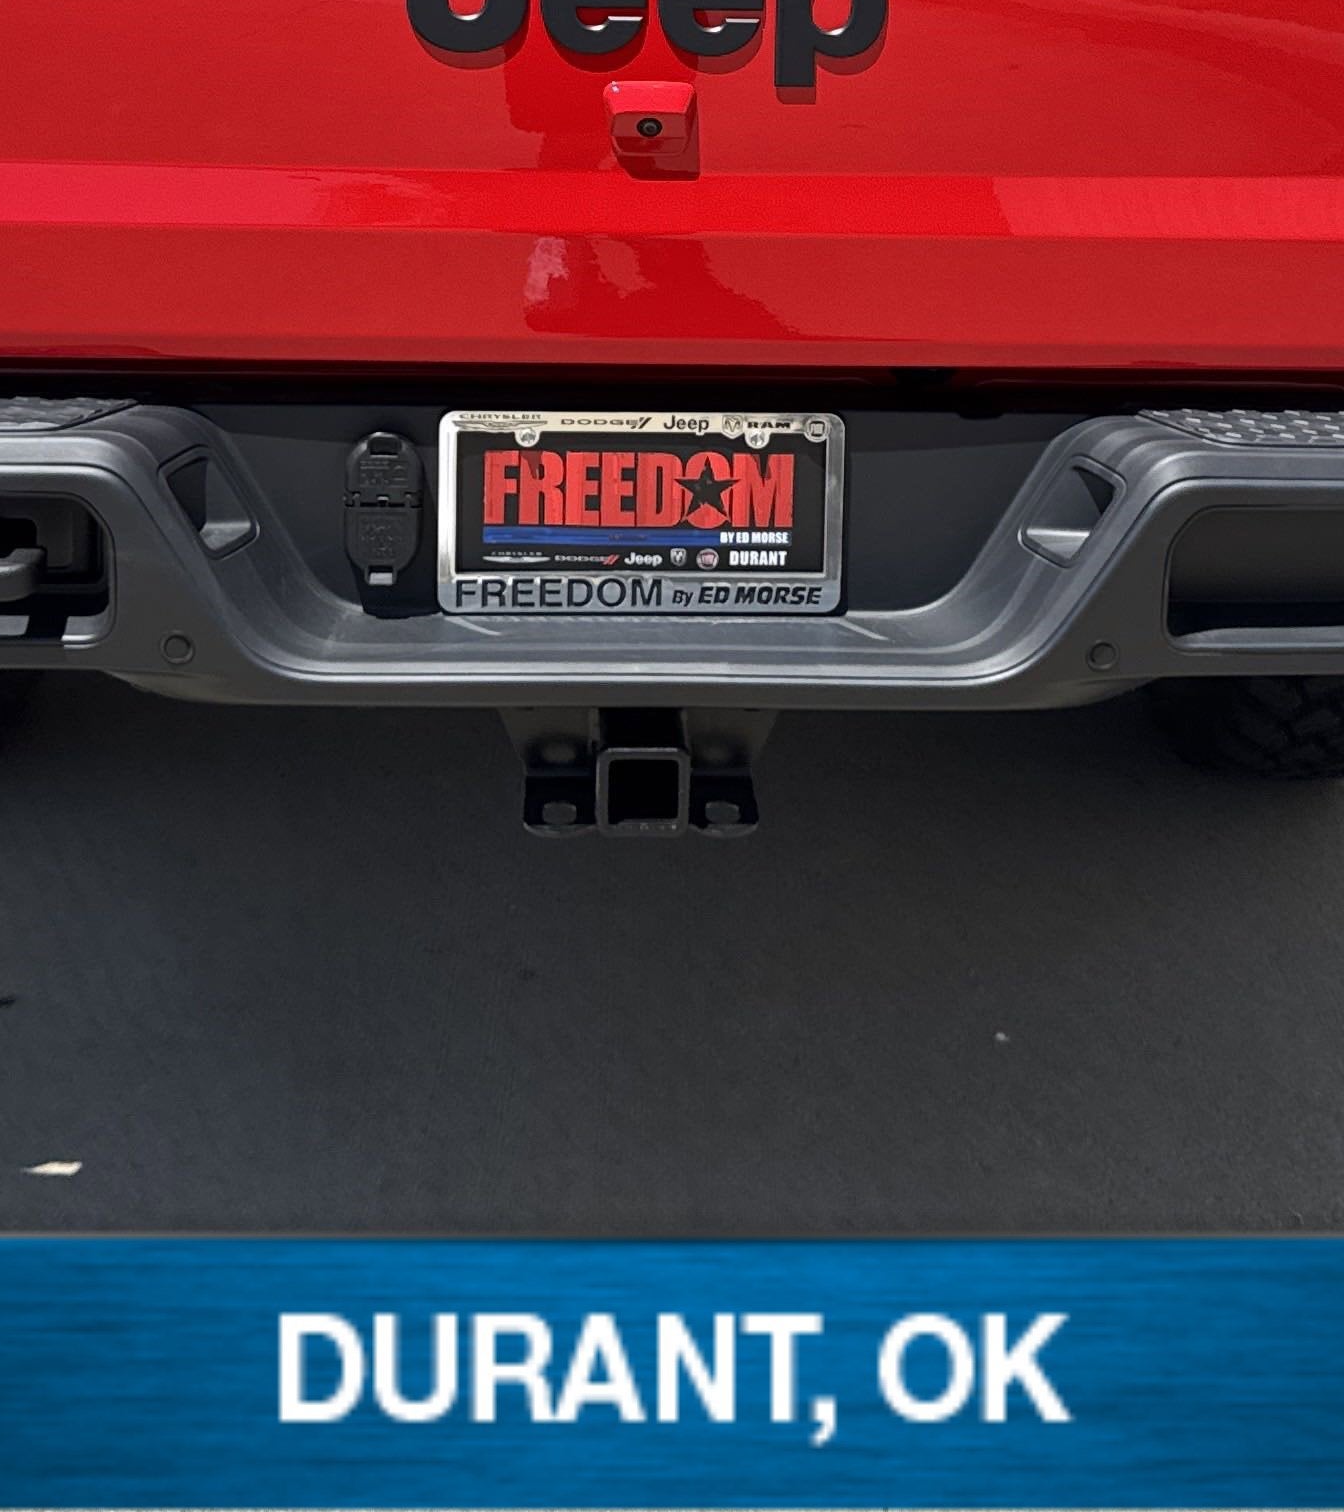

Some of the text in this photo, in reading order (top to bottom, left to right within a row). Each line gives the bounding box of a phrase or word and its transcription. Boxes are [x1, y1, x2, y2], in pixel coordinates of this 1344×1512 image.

[458, 413, 792, 433] CHRYSLER DODGE Jeep RAM
[483, 450, 795, 529] FREEDOM
[720, 531, 789, 544] BY ED MORSE
[624, 551, 663, 567] Jeep
[729, 550, 788, 566] DURANT
[455, 577, 823, 608] FREEDOM By ED MORSE
